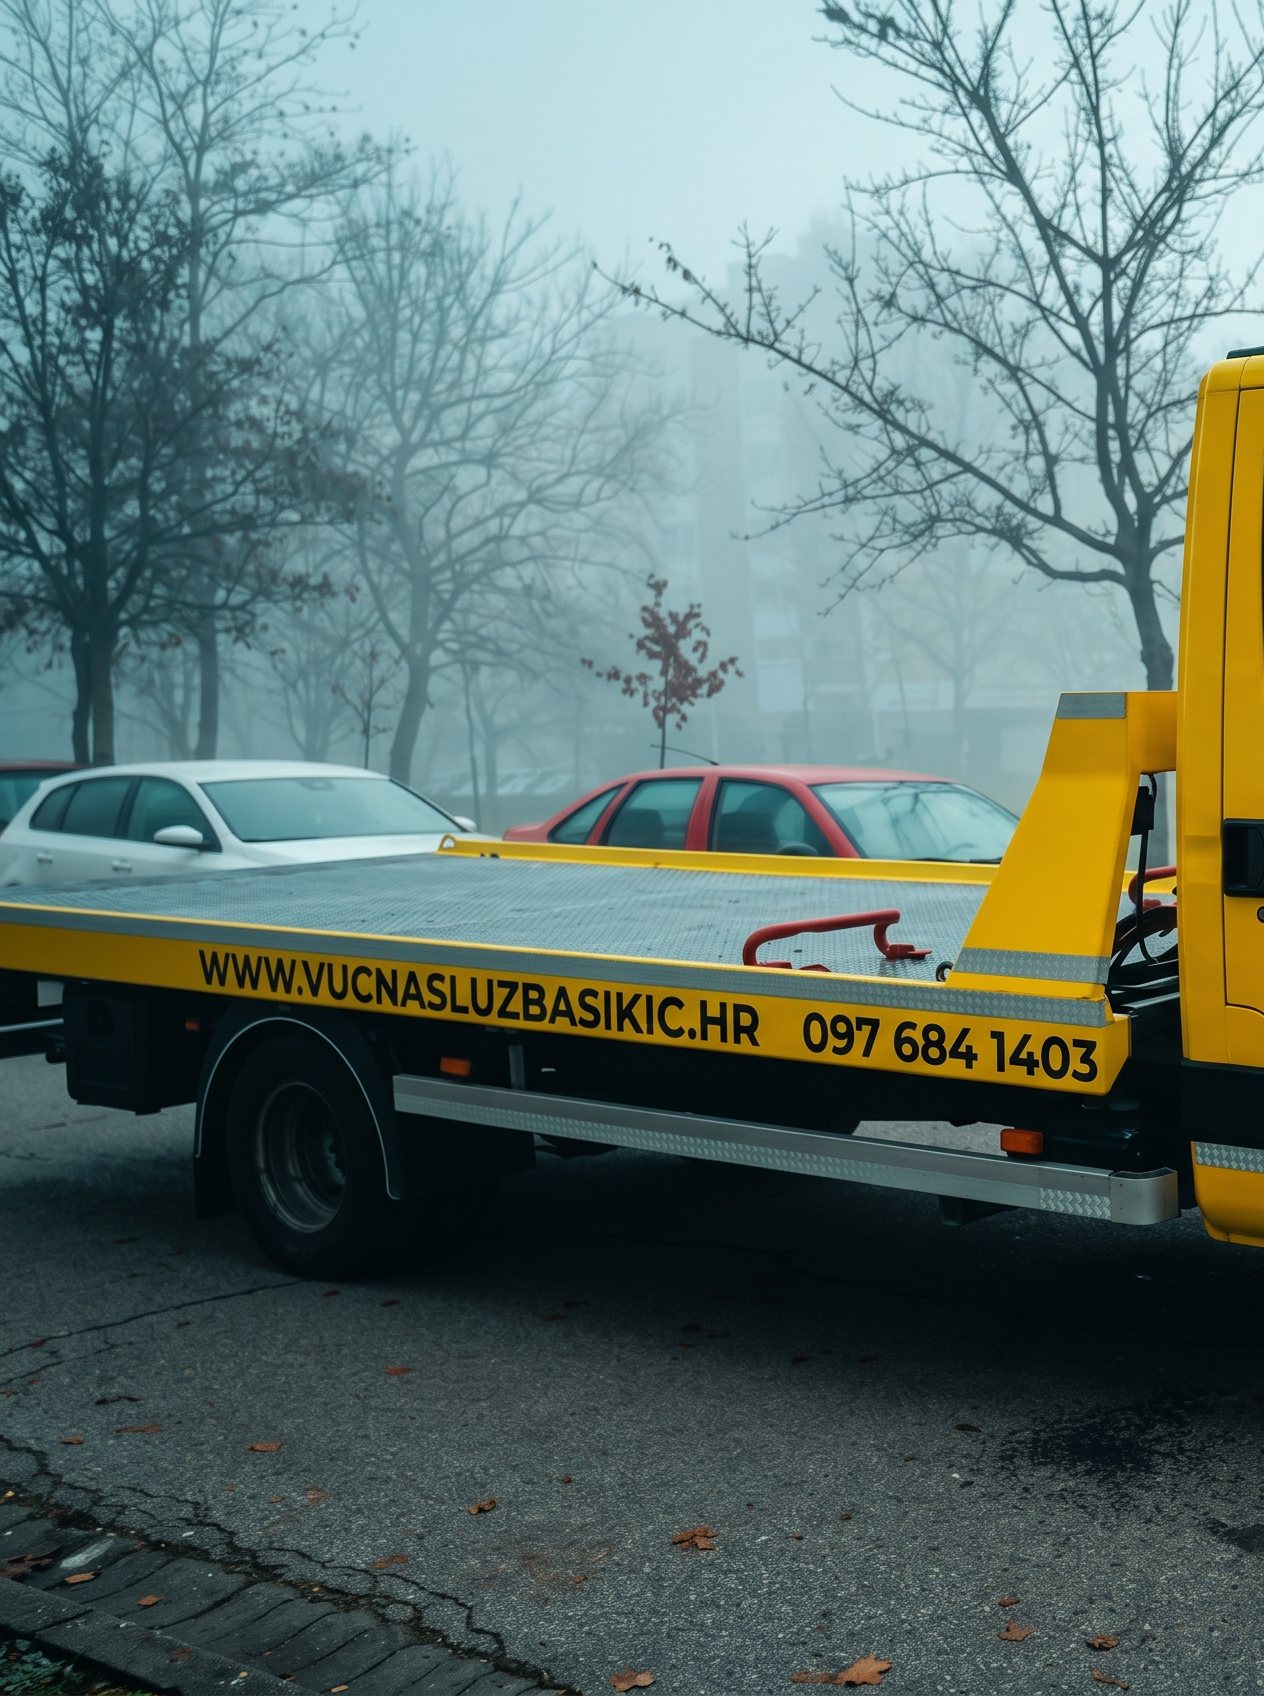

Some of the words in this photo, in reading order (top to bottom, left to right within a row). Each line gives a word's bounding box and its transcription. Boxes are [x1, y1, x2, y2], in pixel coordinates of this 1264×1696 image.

[199, 949, 761, 1047] WWW.VUCNASLUZBASIKIC.HR
[803, 1012, 880, 1058] 097
[893, 1021, 978, 1070] 684
[990, 1030, 1098, 1082] 1403
